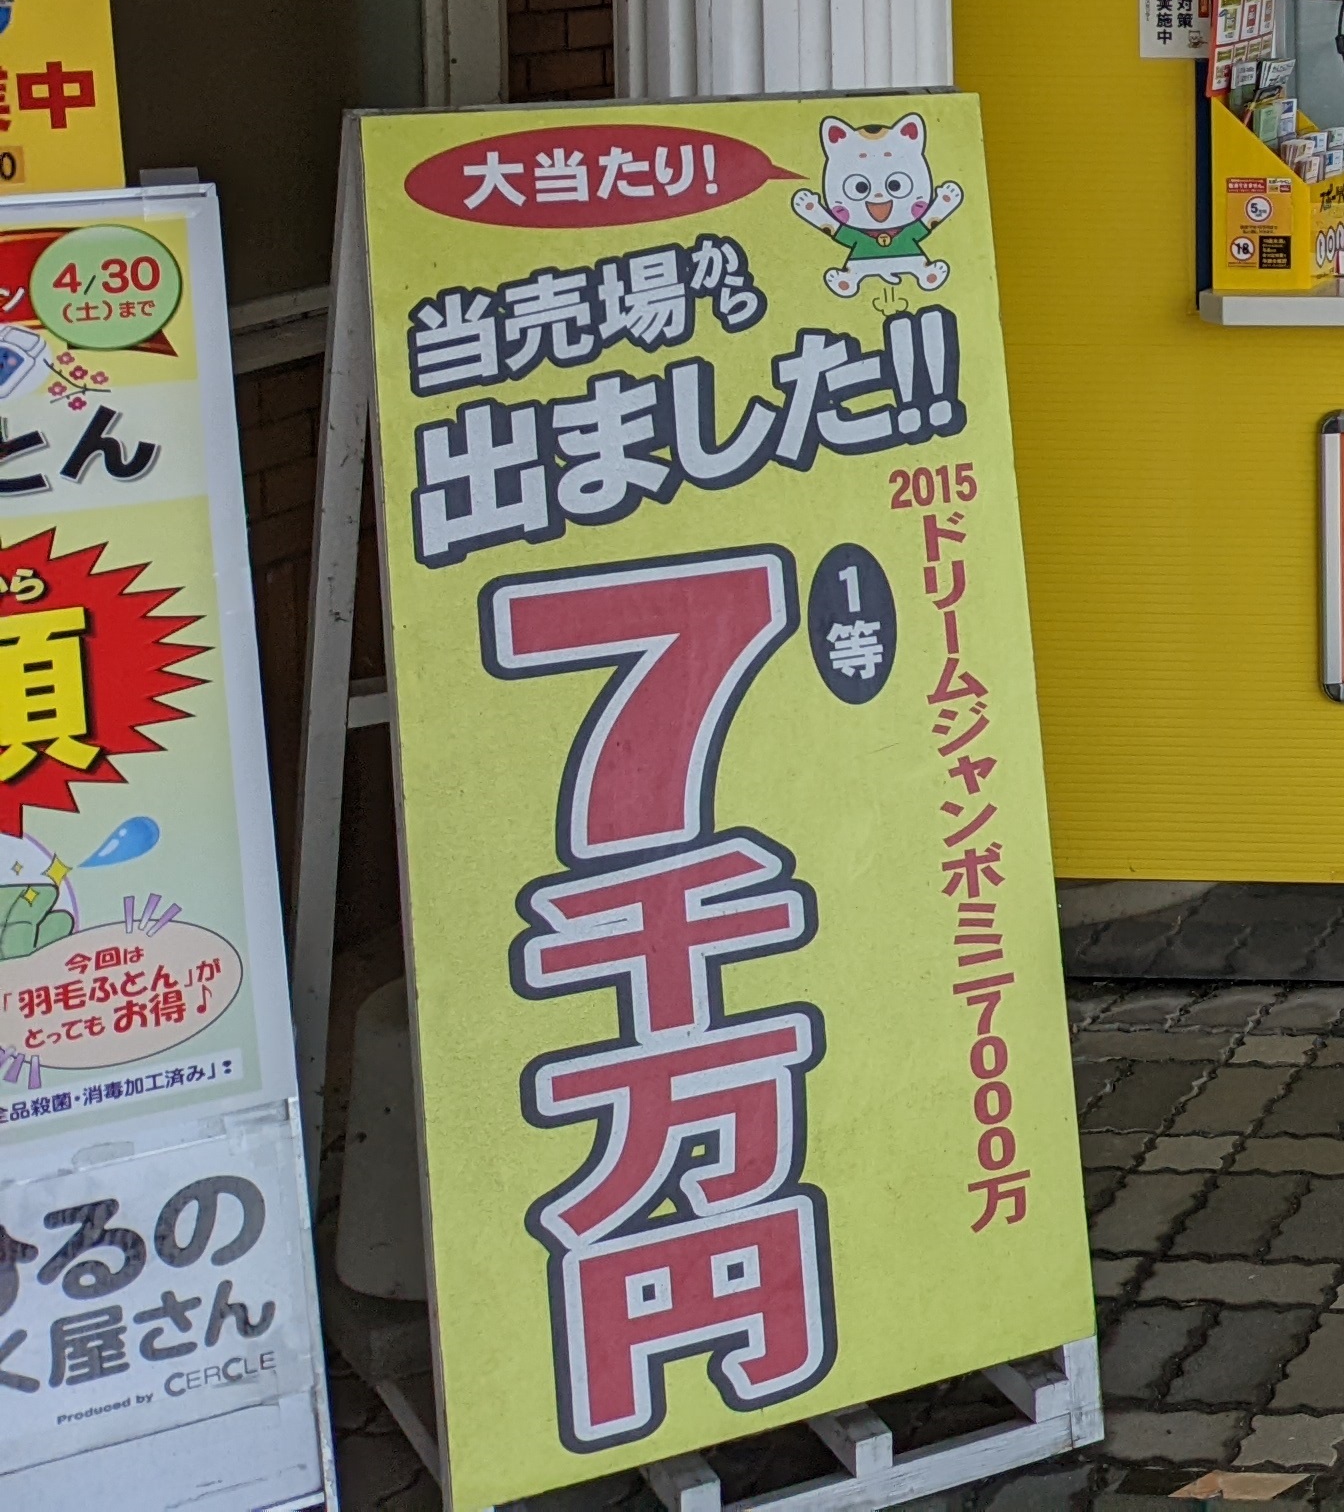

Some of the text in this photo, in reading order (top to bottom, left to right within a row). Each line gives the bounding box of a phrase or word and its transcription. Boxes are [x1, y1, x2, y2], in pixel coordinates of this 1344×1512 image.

[0, 61, 96, 131] 中
[462, 143, 720, 211] 大当たり!
[52, 256, 161, 295] 4/30
[410, 235, 767, 395] 当売場から
[414, 306, 967, 568] 出ました!!
[826, 564, 886, 683] 1等
[888, 462, 1029, 1234] 2015 ドリームジャンボミニ7000万
[65, 944, 145, 976] 今回は
[479, 542, 838, 1455] 7千万円
[57, 1351, 277, 1425] Produced by CERCLE
